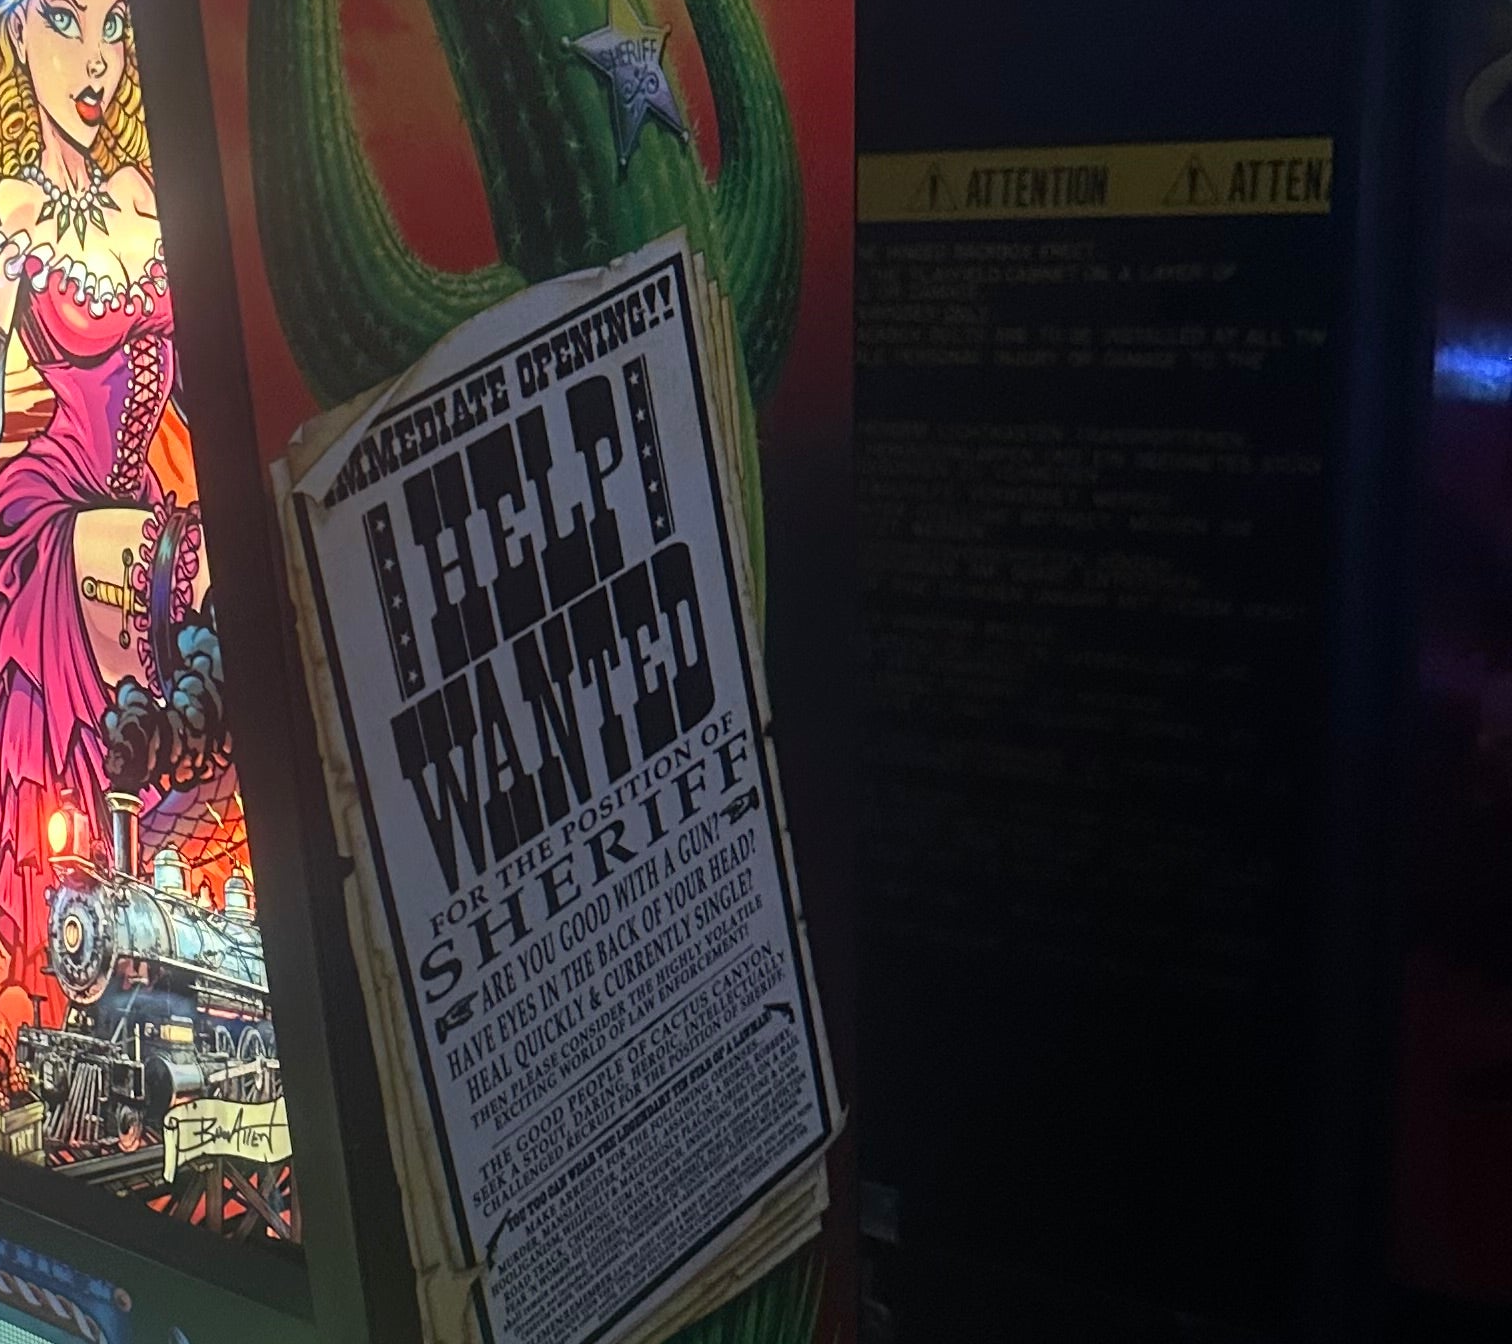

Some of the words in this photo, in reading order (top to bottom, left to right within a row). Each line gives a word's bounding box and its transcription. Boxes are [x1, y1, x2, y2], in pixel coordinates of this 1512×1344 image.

[598, 38, 657, 71] SHERIFF
[965, 164, 1109, 208] ATTENTION
[516, 276, 674, 398] OPENING!!
[403, 375, 624, 680] HELP
[390, 542, 715, 896] WANTED
[430, 885, 488, 939] FOR
[498, 837, 553, 890] THE
[561, 740, 691, 846] POSITION
[701, 711, 732, 746] OF
[420, 729, 747, 1004] SHERIFF
[447, 1024, 496, 1080] HAVE
[497, 993, 536, 1043] EYES
[539, 975, 560, 1011] IN
[561, 949, 594, 993] THE
[596, 915, 640, 968] BACK
[642, 898, 661, 932] OF
[664, 866, 707, 915] YOUR
[708, 828, 755, 884] HEAD?
[482, 962, 516, 1014] ARE
[518, 932, 555, 982] YOU
[560, 893, 610, 952] GOOD
[612, 856, 660, 912] WITH
[664, 848, 676, 878] A
[678, 812, 719, 864] GUN?
[466, 1054, 512, 1104] HEAL
[514, 995, 584, 1068] QUICKLY
[590, 986, 602, 1010] &
[604, 914, 691, 998] CURRENTLY
[695, 868, 752, 930] SINGLE?
[471, 1091, 507, 1129] THEN
[511, 1052, 558, 1098] PLEASE
[561, 1000, 626, 1058] CONSIDER
[628, 978, 653, 1006] THE
[656, 941, 701, 986] HIGHLY
[705, 894, 762, 946] VOLATILE
[473, 1172, 506, 1208] SEEK
[512, 1163, 520, 1178] A
[523, 1123, 570, 1167] STOUT,
[573, 1077, 628, 1127] DARING,
[685, 952, 784, 1038] INTELLECTUALLY
[479, 1146, 512, 1181] THE
[516, 1106, 563, 1152] GOOD
[568, 1058, 624, 1112] PEOPLE
[628, 1040, 646, 1064] OF
[651, 991, 708, 1046] CACTUS
[712, 941, 771, 997] CANYON
[494, 1072, 557, 1131] EXCITING
[559, 1034, 606, 1078] WORLD
[609, 1018, 625, 1040] OF
[628, 995, 654, 1026] LAW
[658, 923, 748, 1002] ENFORCEMENT!
[483, 1145, 563, 1218] CHALLENGED
[567, 1101, 615, 1151] RECRUIT
[619, 1083, 641, 1108] FOR
[644, 1062, 666, 1087] THE
[669, 1017, 721, 1068] POSITION
[724, 1004, 737, 1023] OF
[525, 1204, 556, 1236] MAKE
[560, 1165, 604, 1210] ARRESTS
